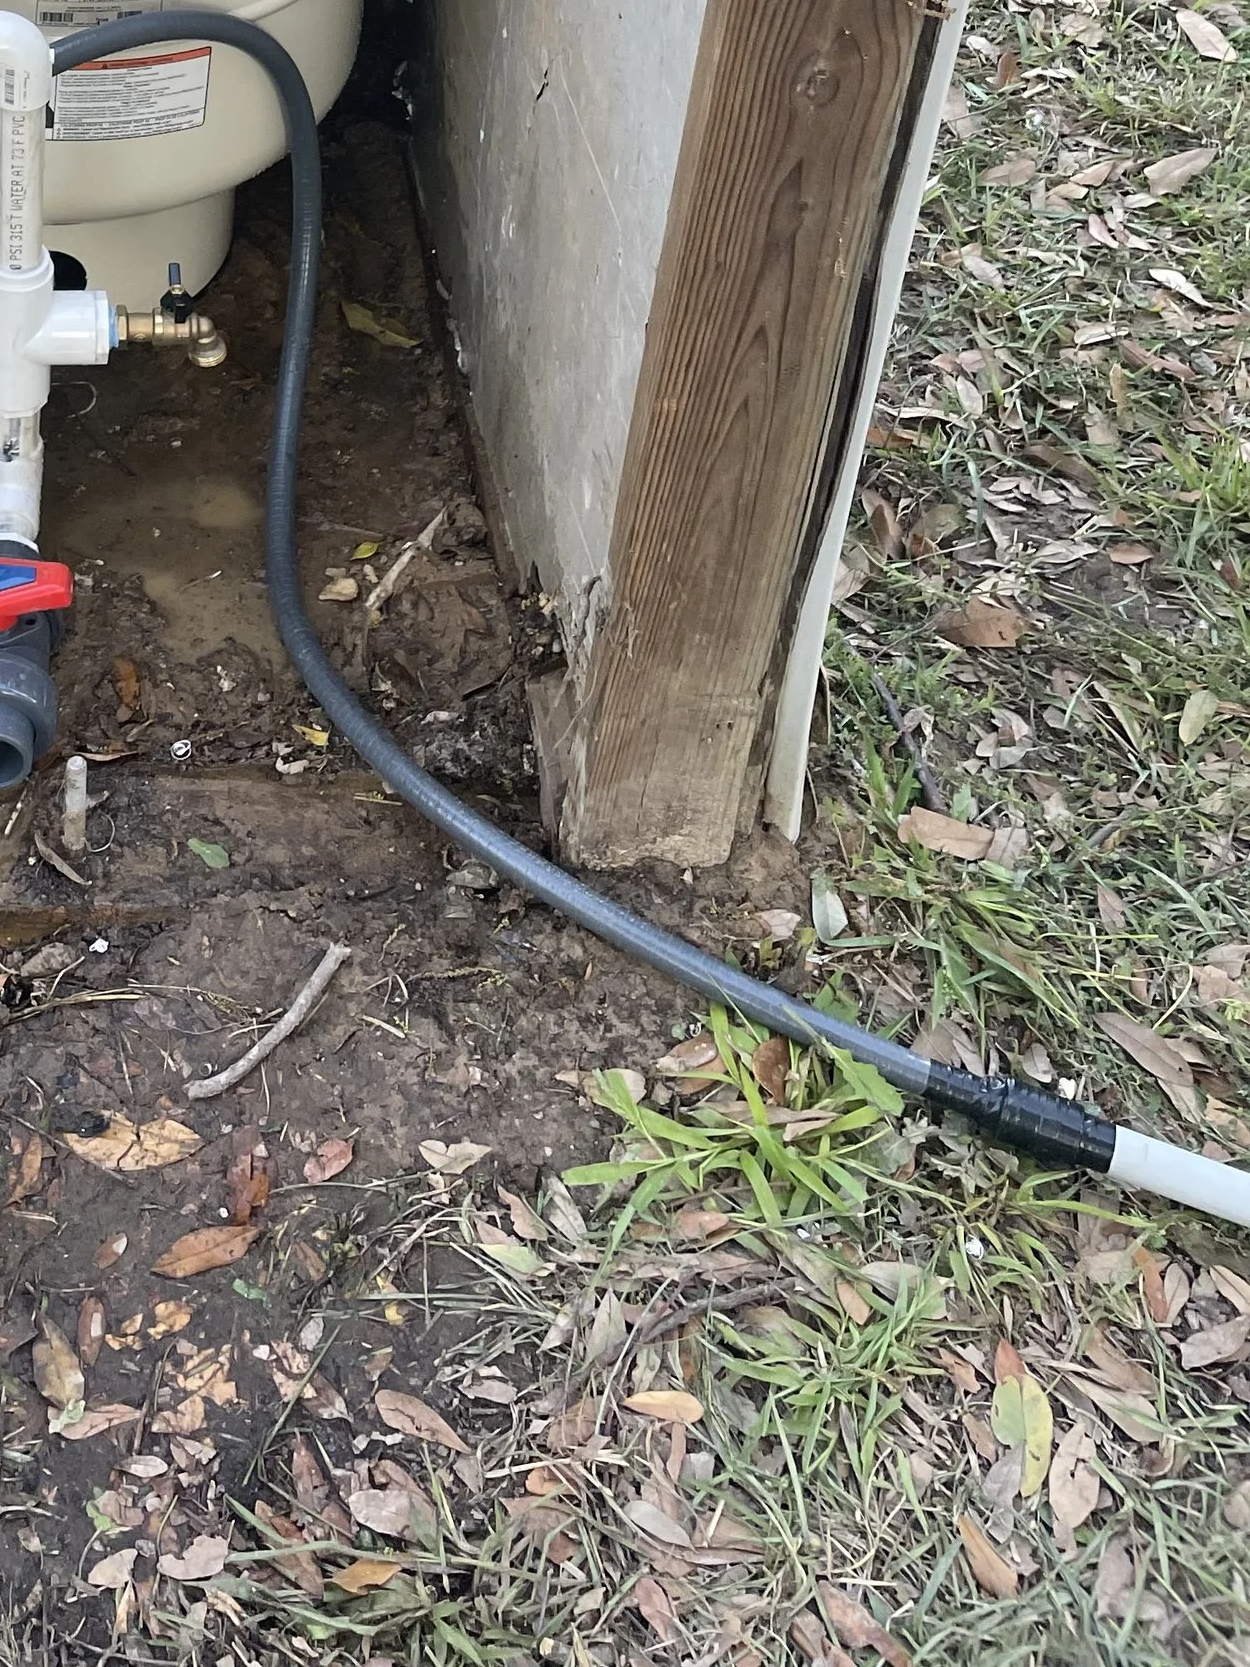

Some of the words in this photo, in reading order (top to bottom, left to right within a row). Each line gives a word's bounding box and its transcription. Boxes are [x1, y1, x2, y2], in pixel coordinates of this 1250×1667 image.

[12, 116, 26, 135] PVC
[11, 164, 25, 177] AT
[10, 180, 25, 211] WATER
[9, 224, 23, 241] 315
[9, 244, 23, 261] PSI
